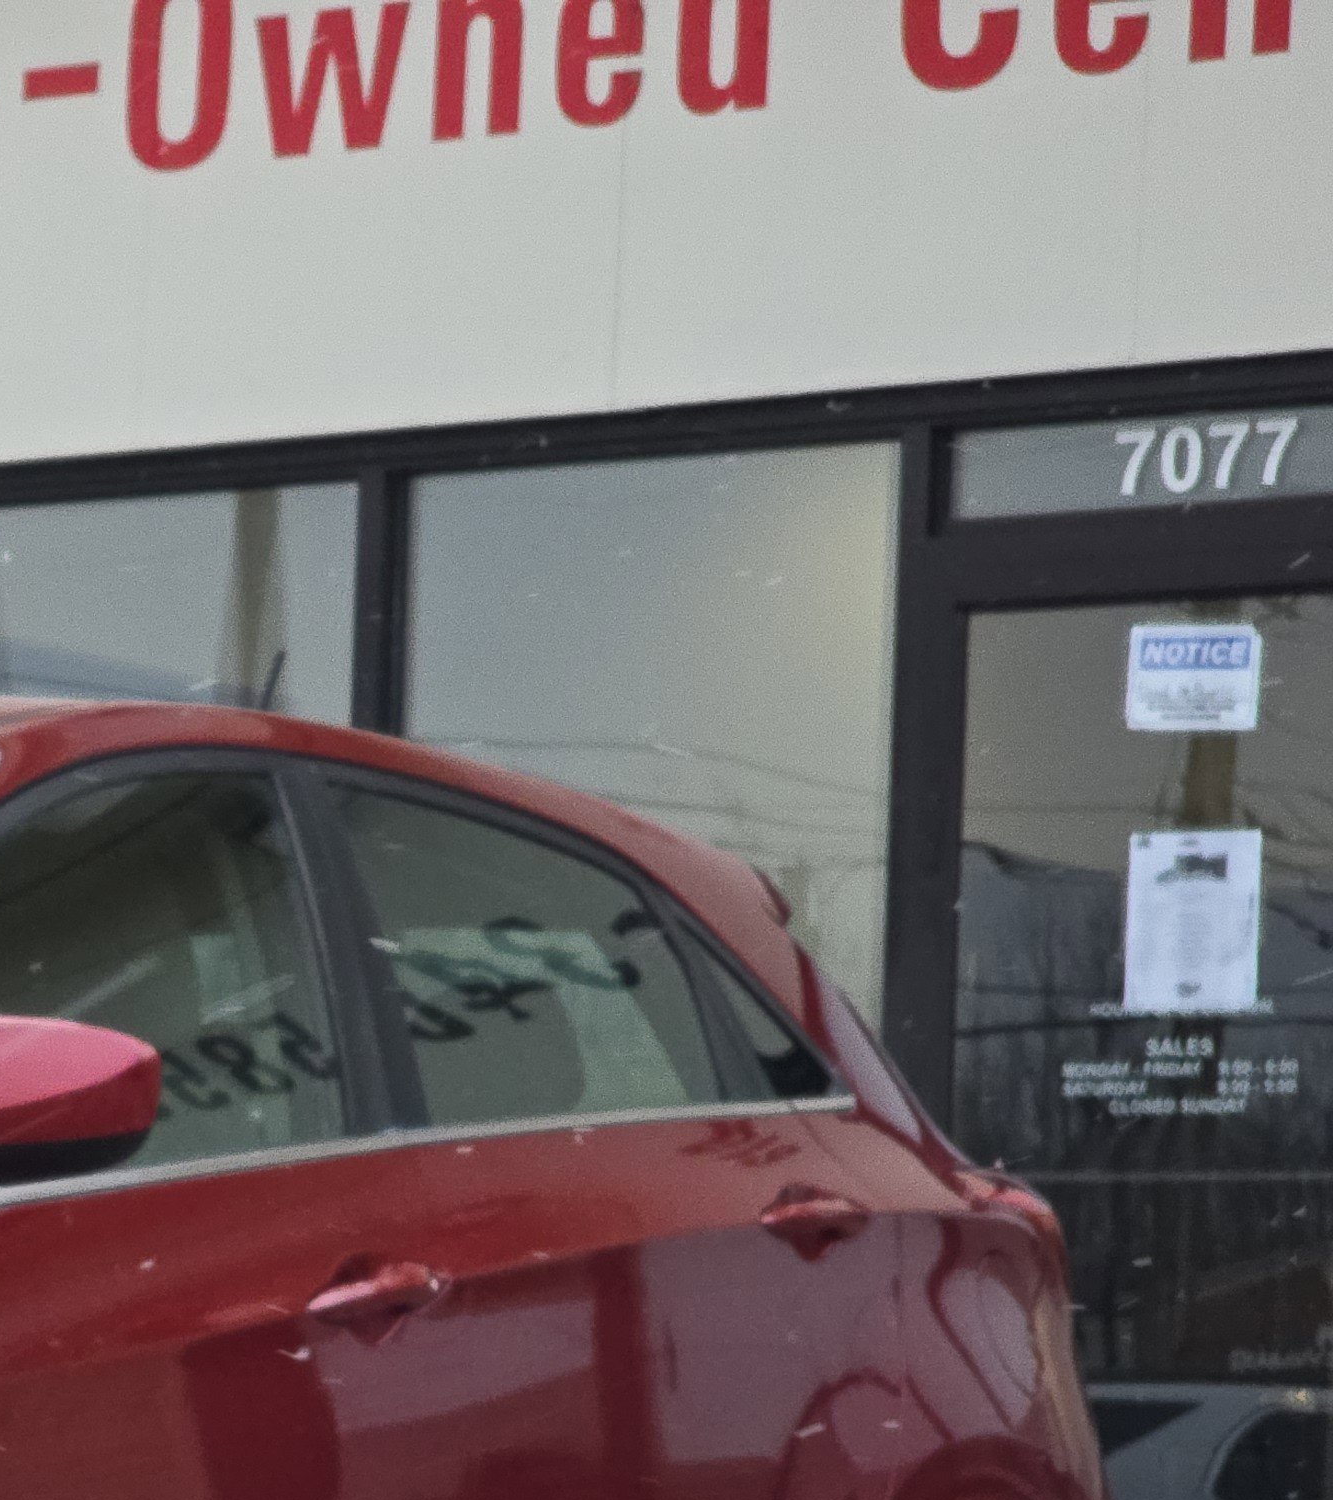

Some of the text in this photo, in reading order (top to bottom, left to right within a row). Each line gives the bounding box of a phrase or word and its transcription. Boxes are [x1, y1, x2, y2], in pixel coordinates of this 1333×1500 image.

[1114, 416, 1299, 497] 7077
[1143, 638, 1248, 666] NOTICE
[1145, 1036, 1214, 1057] SALES
